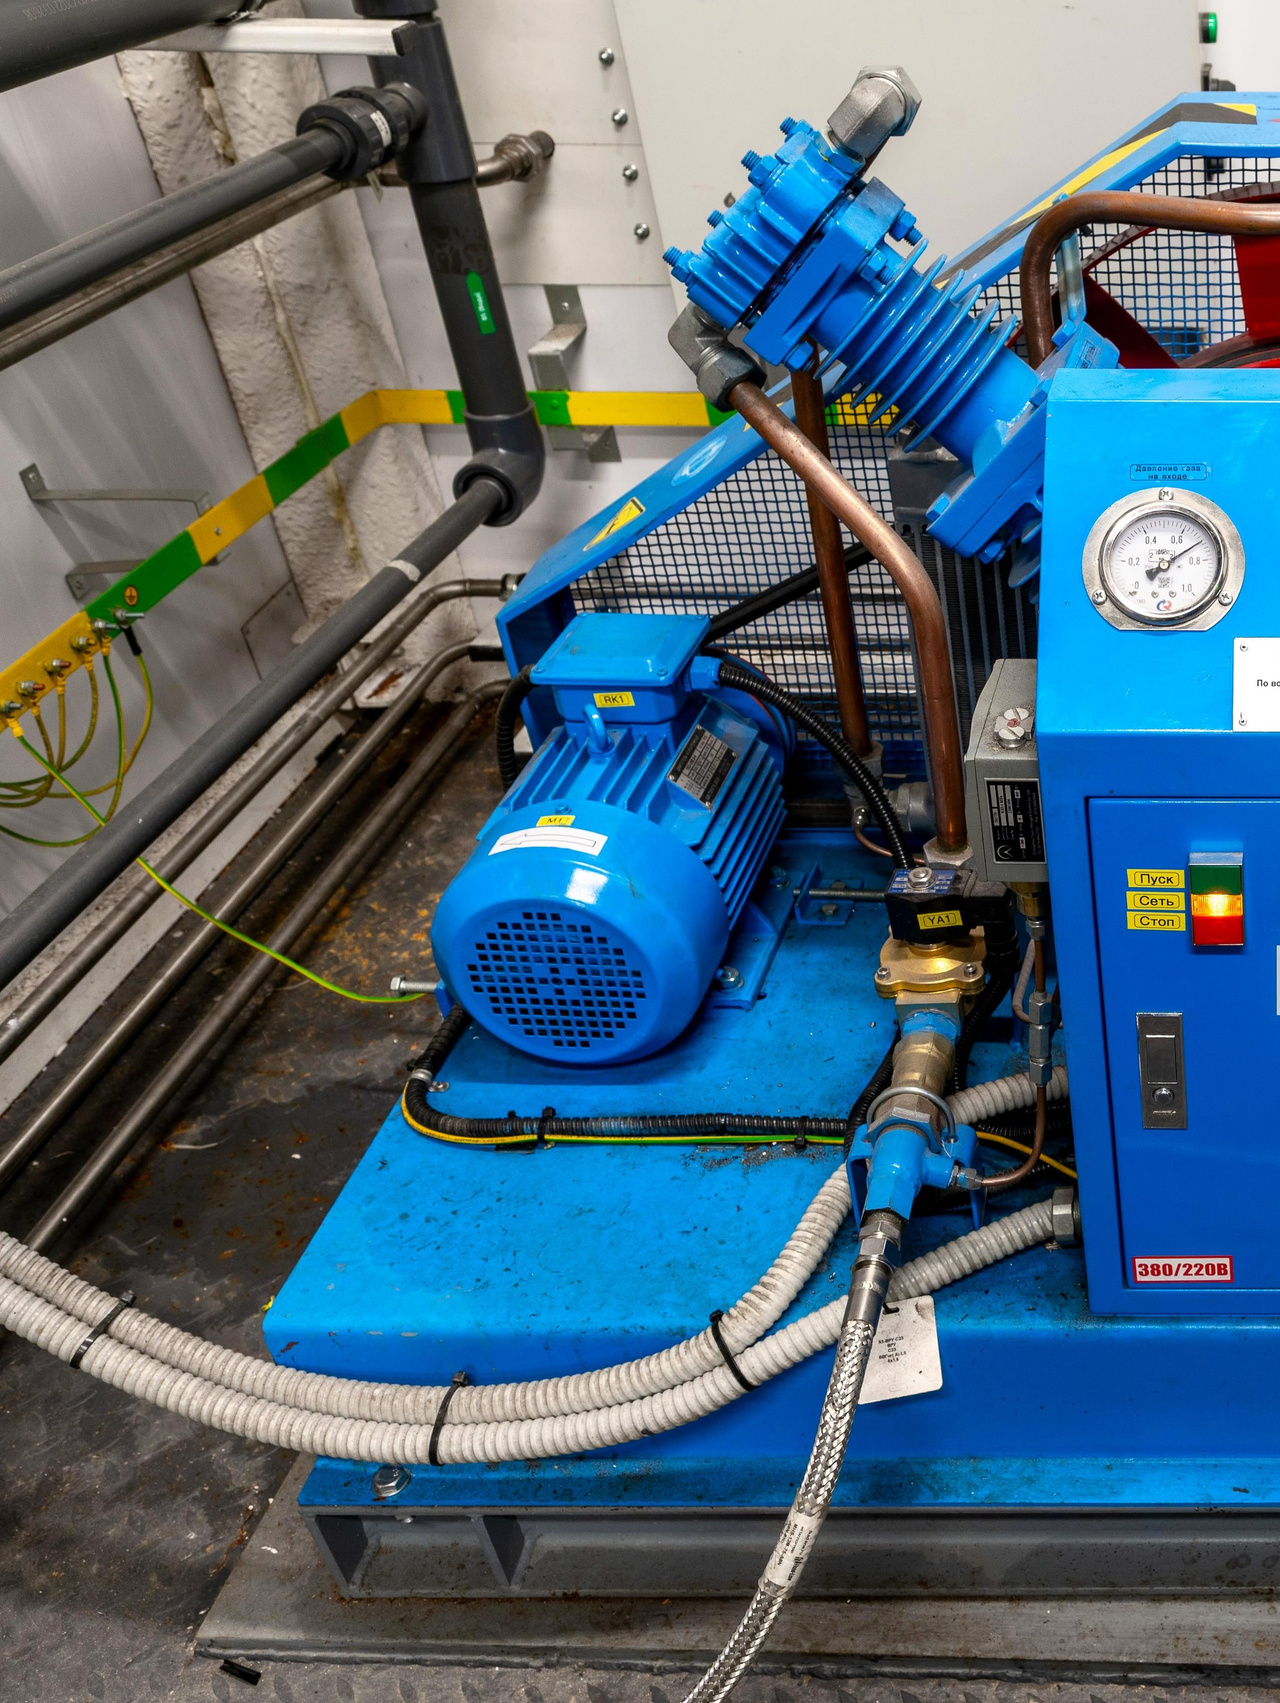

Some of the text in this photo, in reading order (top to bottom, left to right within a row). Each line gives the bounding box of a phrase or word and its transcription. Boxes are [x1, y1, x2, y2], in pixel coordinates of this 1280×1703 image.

[1145, 535, 1157, 546] 0,4
[1170, 535, 1183, 546] 0,6
[1128, 557, 1140, 567] 0,2
[1188, 556, 1201, 566] 0,8
[1182, 583, 1193, 593] 1,0
[1256, 679, 1269, 687] По
[603, 695, 624, 704] RK1
[1140, 873, 1174, 886] Пуск
[1139, 895, 1174, 906] Сеть
[927, 915, 951, 925] YA1
[1139, 915, 1175, 926] Стоп
[1137, 1263, 1229, 1277] 380/220В
